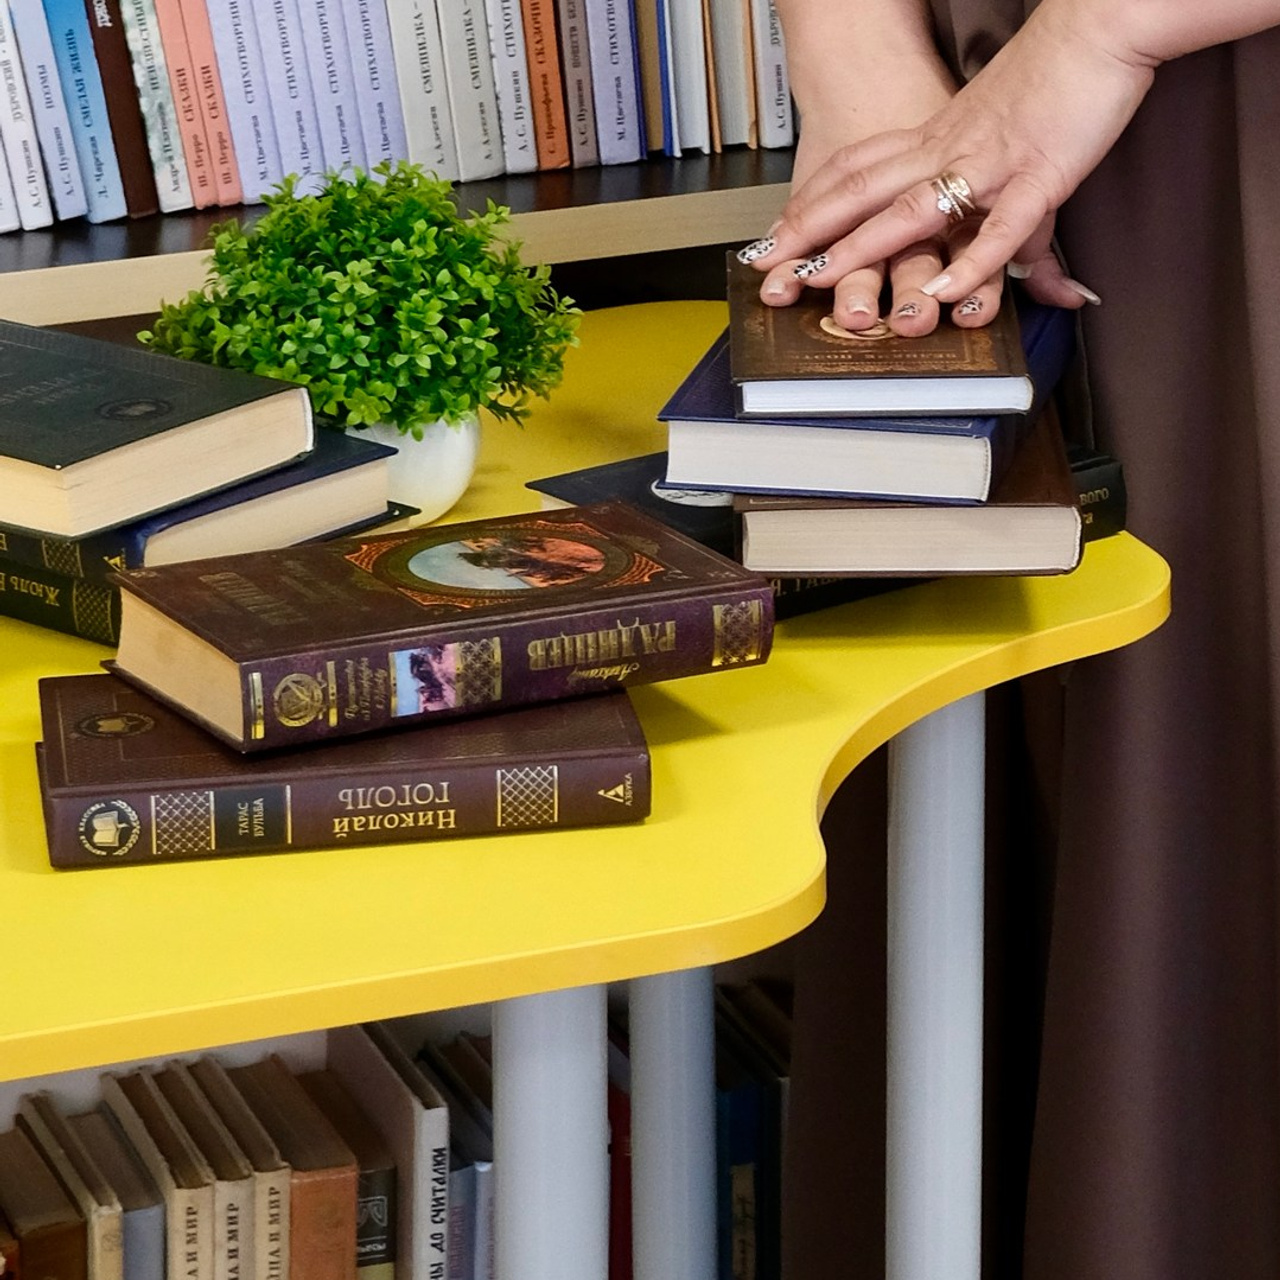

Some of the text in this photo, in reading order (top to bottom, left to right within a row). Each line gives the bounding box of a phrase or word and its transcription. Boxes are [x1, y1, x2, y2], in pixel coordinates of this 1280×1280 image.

[415, 12, 433, 94] СМЕШИЛКА
[463, 9, 483, 90] СМЕШИЛКА
[569, 26, 581, 68] ПОВЕСТИ
[65, 29, 105, 182] Чарская СМЕЛАЯ ЖИЗНЬ
[510, 71, 524, 120] Пушкин
[574, 79, 586, 121] Пушкин
[614, 76, 626, 125] Цветаева
[774, 64, 785, 106] Пушкин
[37, 64, 70, 170] Пушкин ПОЭМЫ
[176, 68, 205, 167] Перро СКАЗКИ
[200, 65, 230, 164] Перро СКАЗКИ
[295, 110, 310, 160] Цветаева
[335, 105, 351, 154] Цветаева
[376, 102, 391, 151] Цветаева
[21, 140, 36, 183] Пушкин
[250, 115, 267, 165] Цветаева
[9, 576, 60, 607] Жюль
[526, 617, 676, 670] РАДИЩЕВ
[338, 781, 451, 812] ГОГОЛЬ
[625, 772, 633, 806] АЗБУКА
[237, 802, 249, 835] ТАРАС
[253, 798, 264, 837] БУЛЬБА
[333, 806, 457, 837] Николай
[186, 1206, 198, 1244] МИР
[227, 1203, 239, 1242] МИР
[269, 1186, 280, 1225] МИР
[430, 1148, 446, 1253] ДО СЧИТАЛКИ
